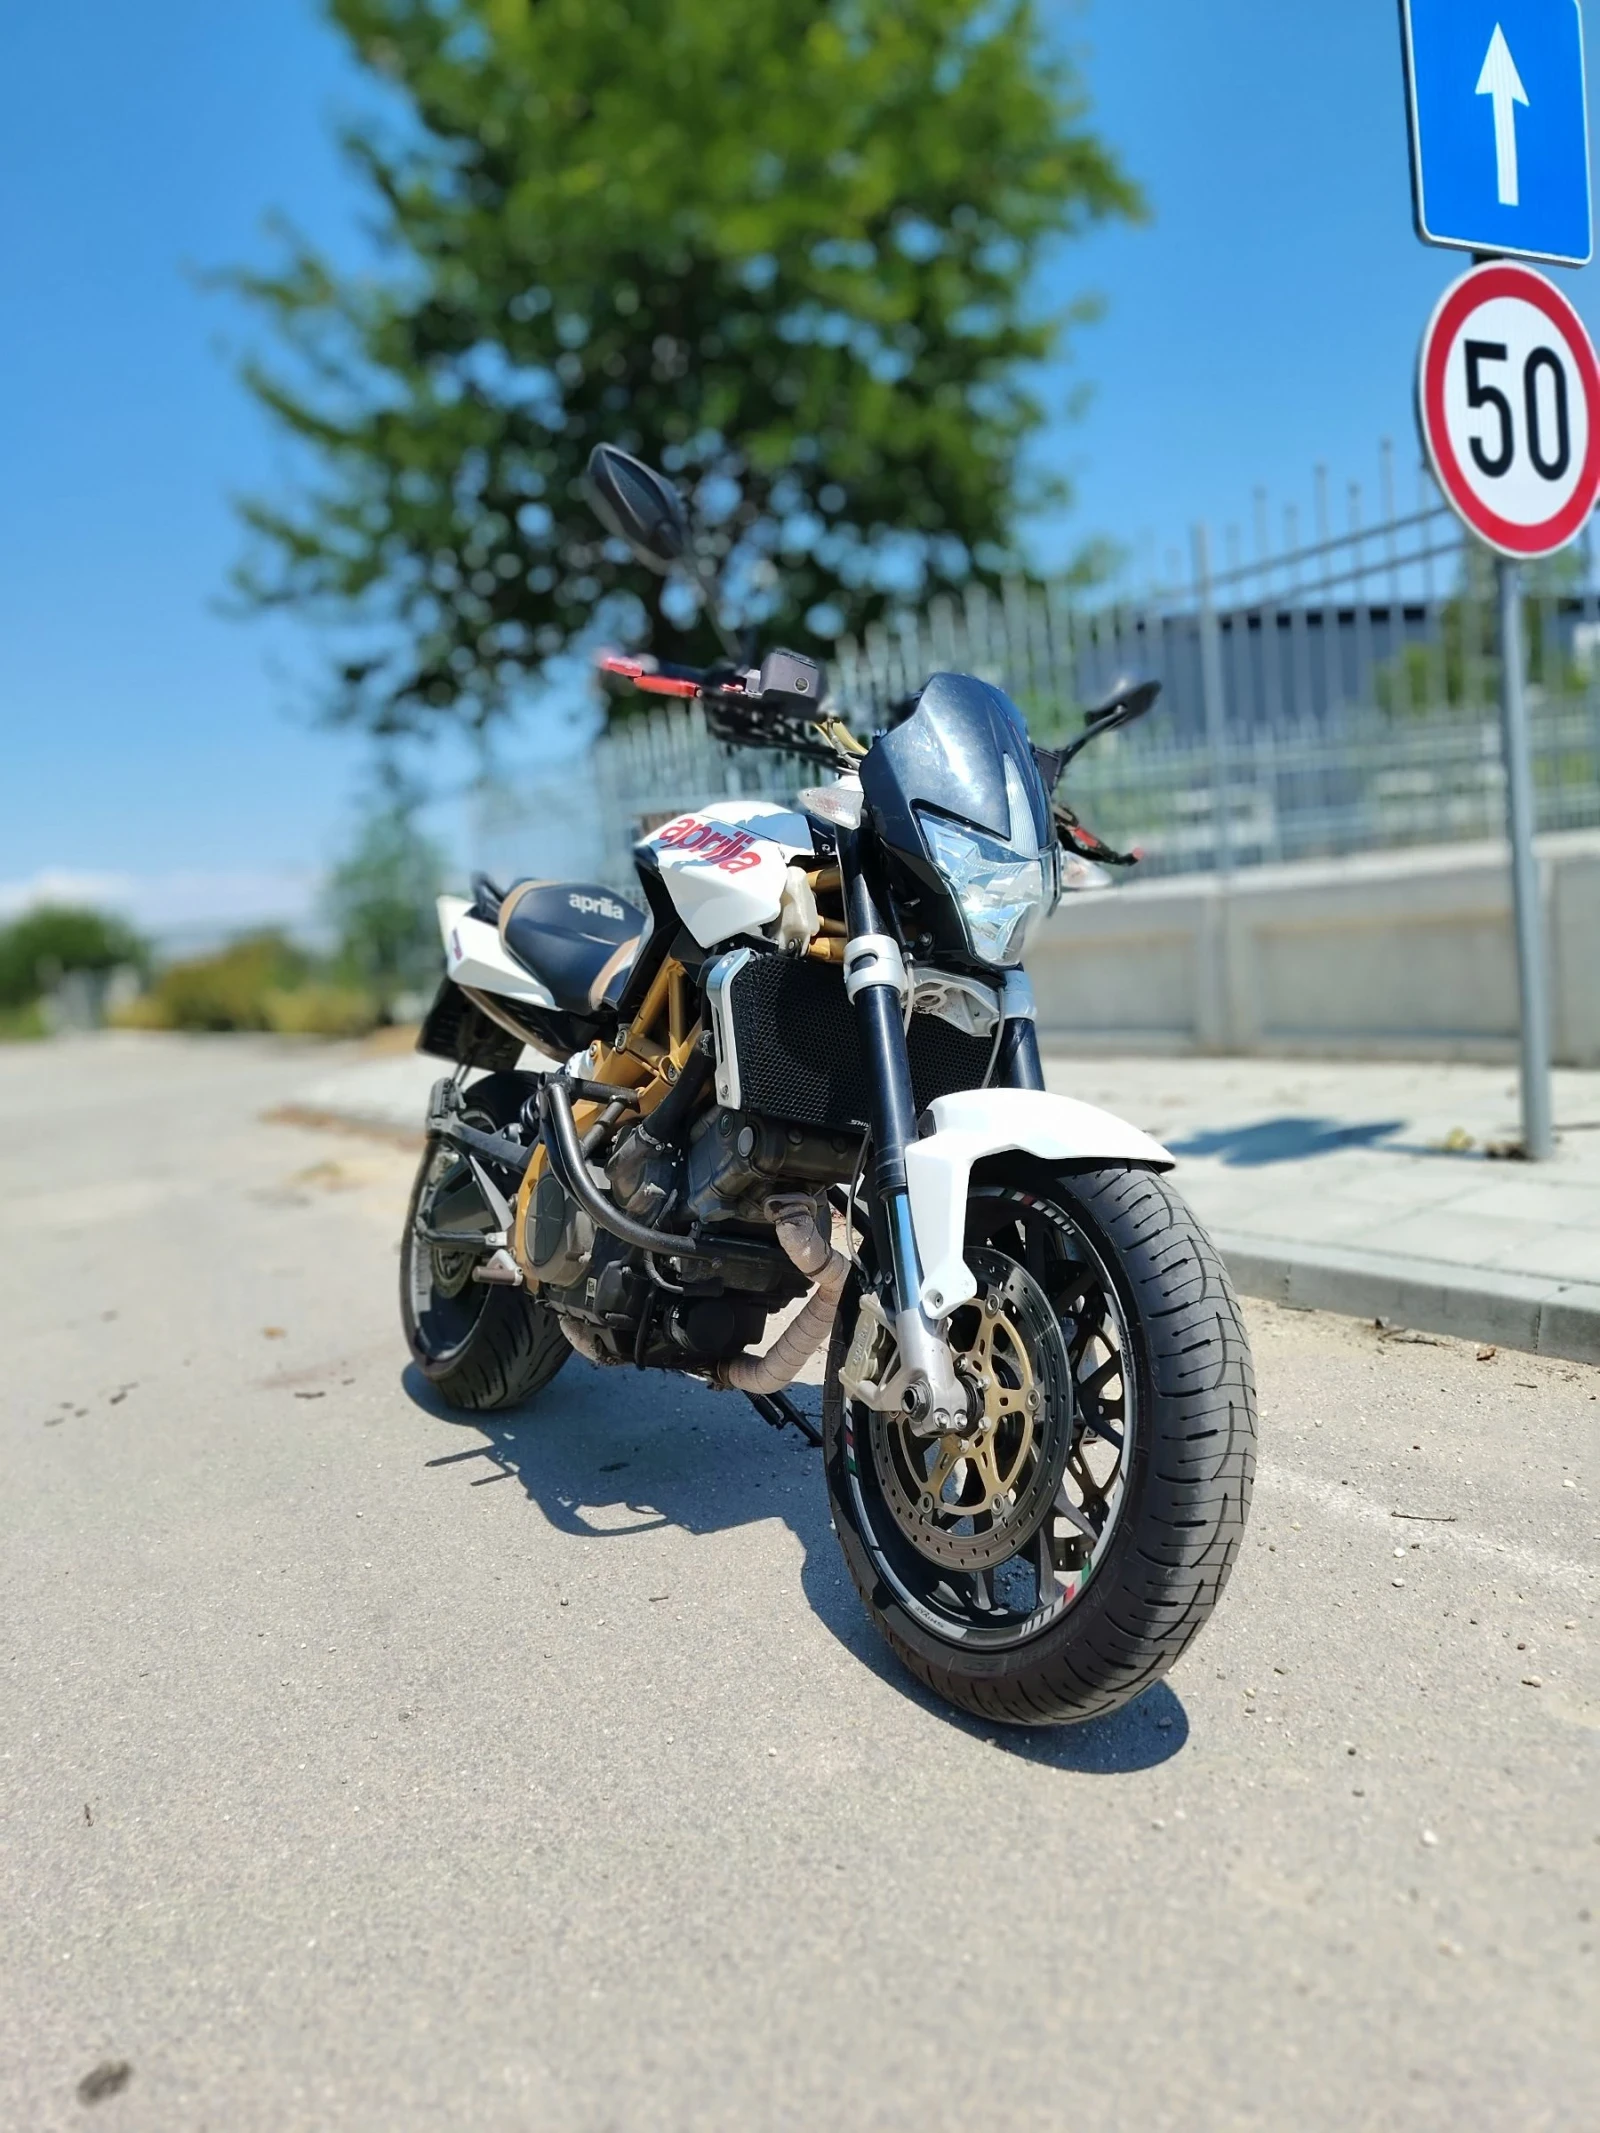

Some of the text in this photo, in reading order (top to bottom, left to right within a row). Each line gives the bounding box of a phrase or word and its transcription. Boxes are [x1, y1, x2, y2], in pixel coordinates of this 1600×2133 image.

[1464, 339, 1570, 482] 50
[659, 818, 761, 874] aprilia
[568, 893, 625, 921] aprilia
